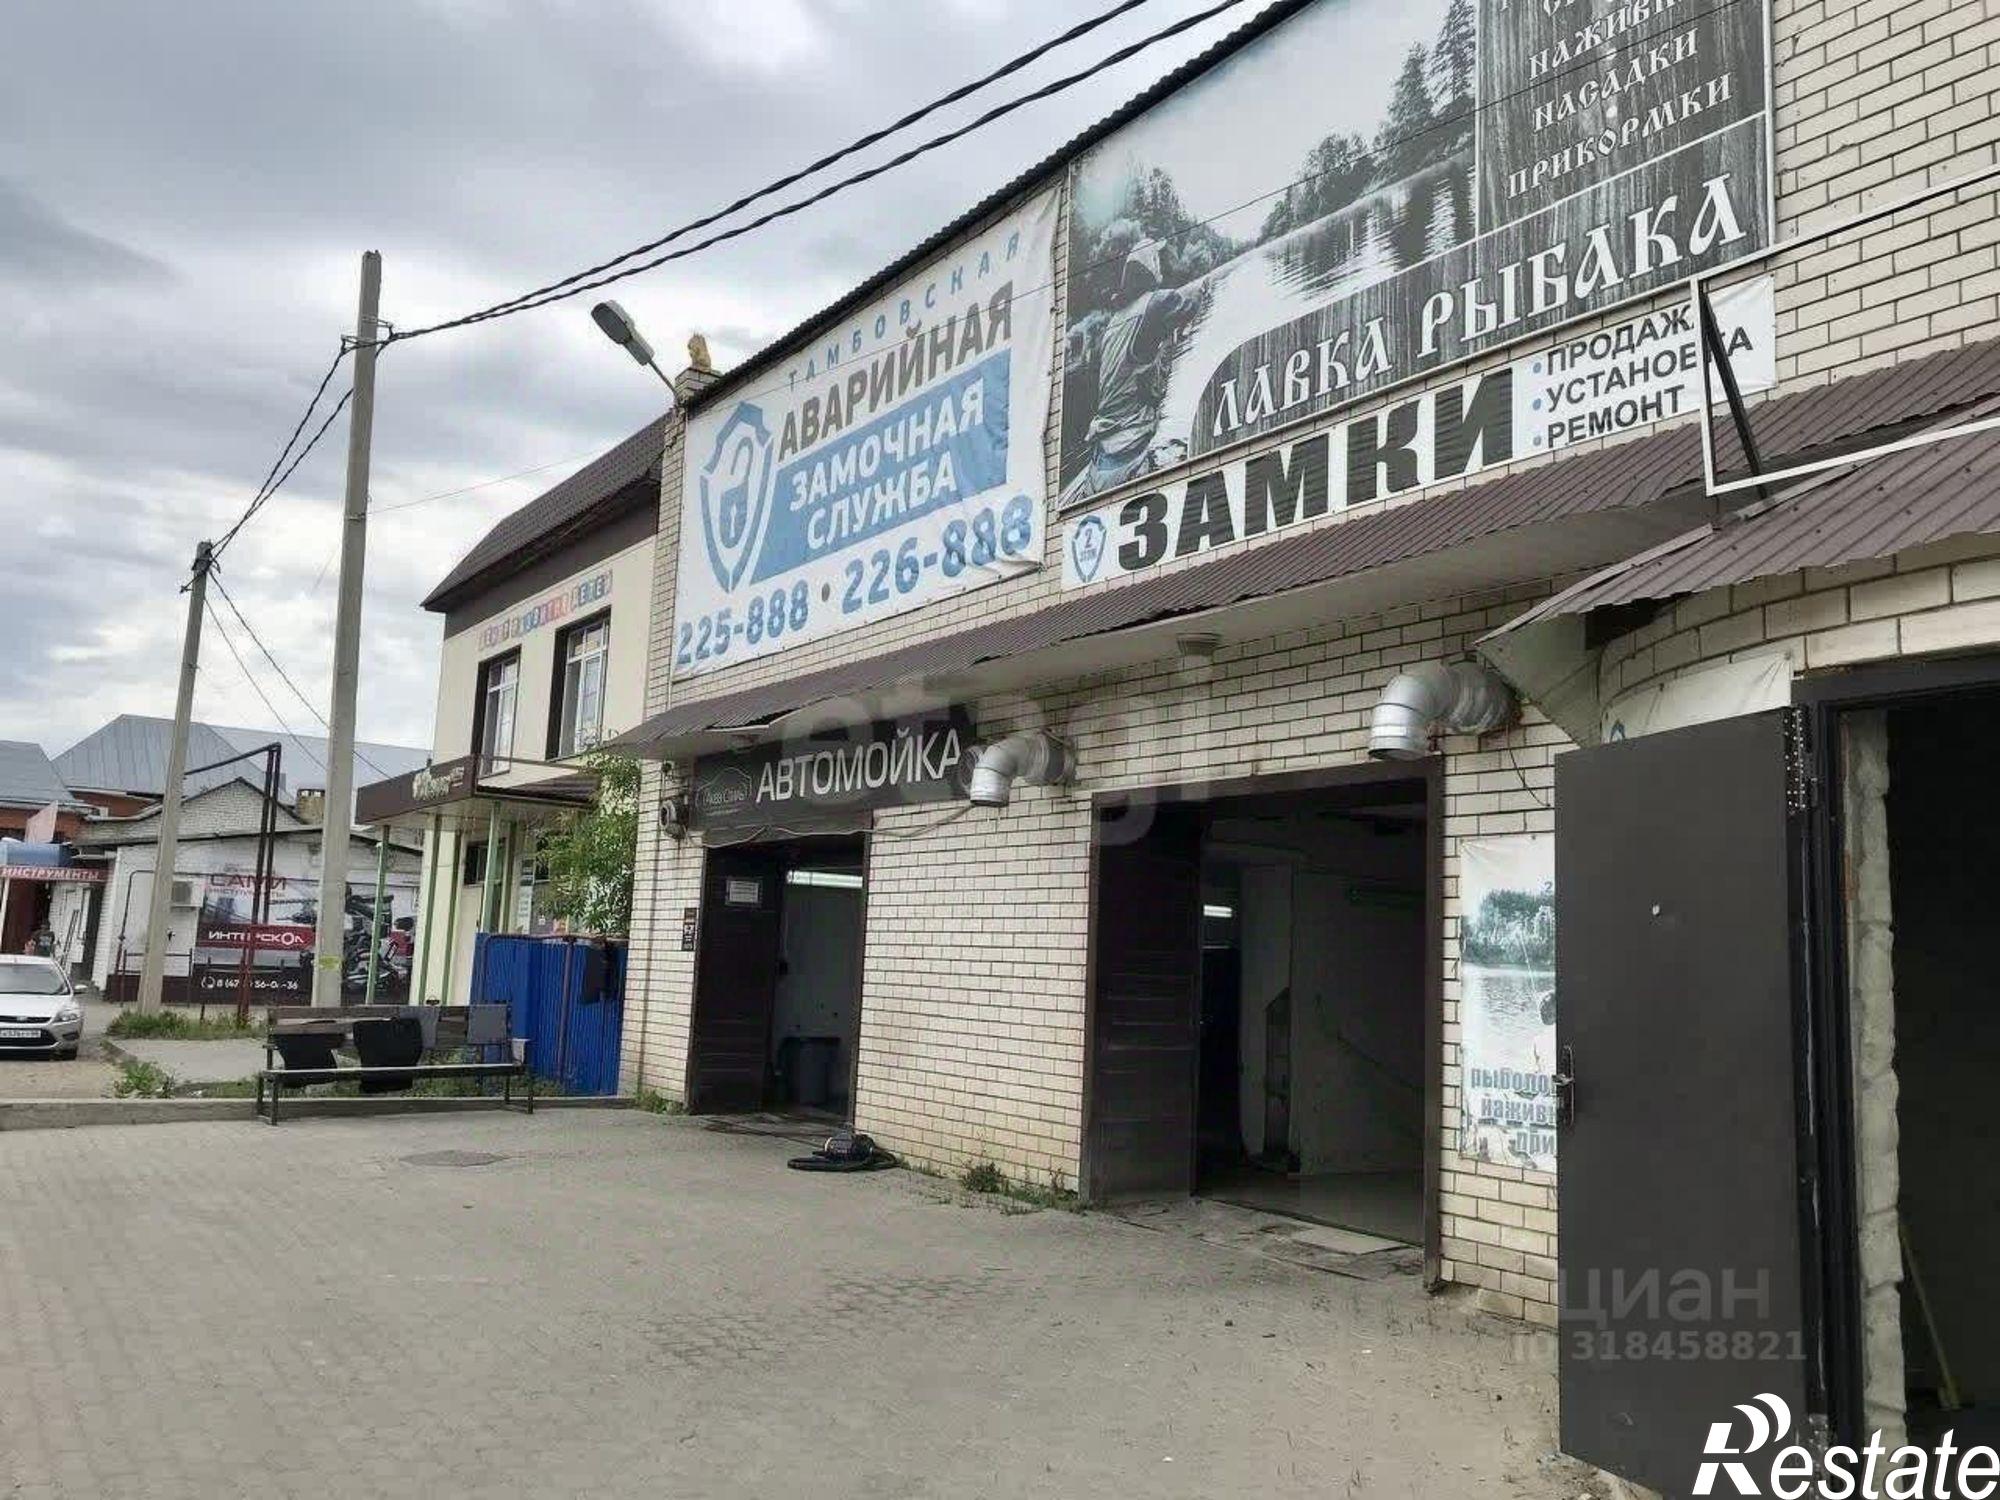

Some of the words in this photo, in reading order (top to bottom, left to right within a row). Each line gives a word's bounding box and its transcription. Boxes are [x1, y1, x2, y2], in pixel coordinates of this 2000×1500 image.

[1507, 72, 1733, 199] ПРИКОРМКИ
[1533, 28, 1699, 133] НАСАДКИ
[788, 231, 1020, 390] ТАМБОВСКАЯ
[1213, 315, 1393, 437] ЛАВКА
[1417, 172, 1747, 358] РЫБАКА
[1547, 304, 1695, 376] ПРОДАЖ
[777, 280, 1014, 462] АВАРИЙНАЯ
[1545, 326, 1754, 413] УСТАНОВА
[1547, 384, 1685, 449] РЕМОНТ
[788, 376, 985, 512] ЗАМОЧНАЯ
[806, 450, 958, 551] СЛУЖБА
[1117, 367, 1514, 571] ЗАМКИ
[676, 579, 809, 665] 225-888
[841, 494, 1034, 615] 226-888
[756, 727, 963, 804] АВТОМОЙКА
